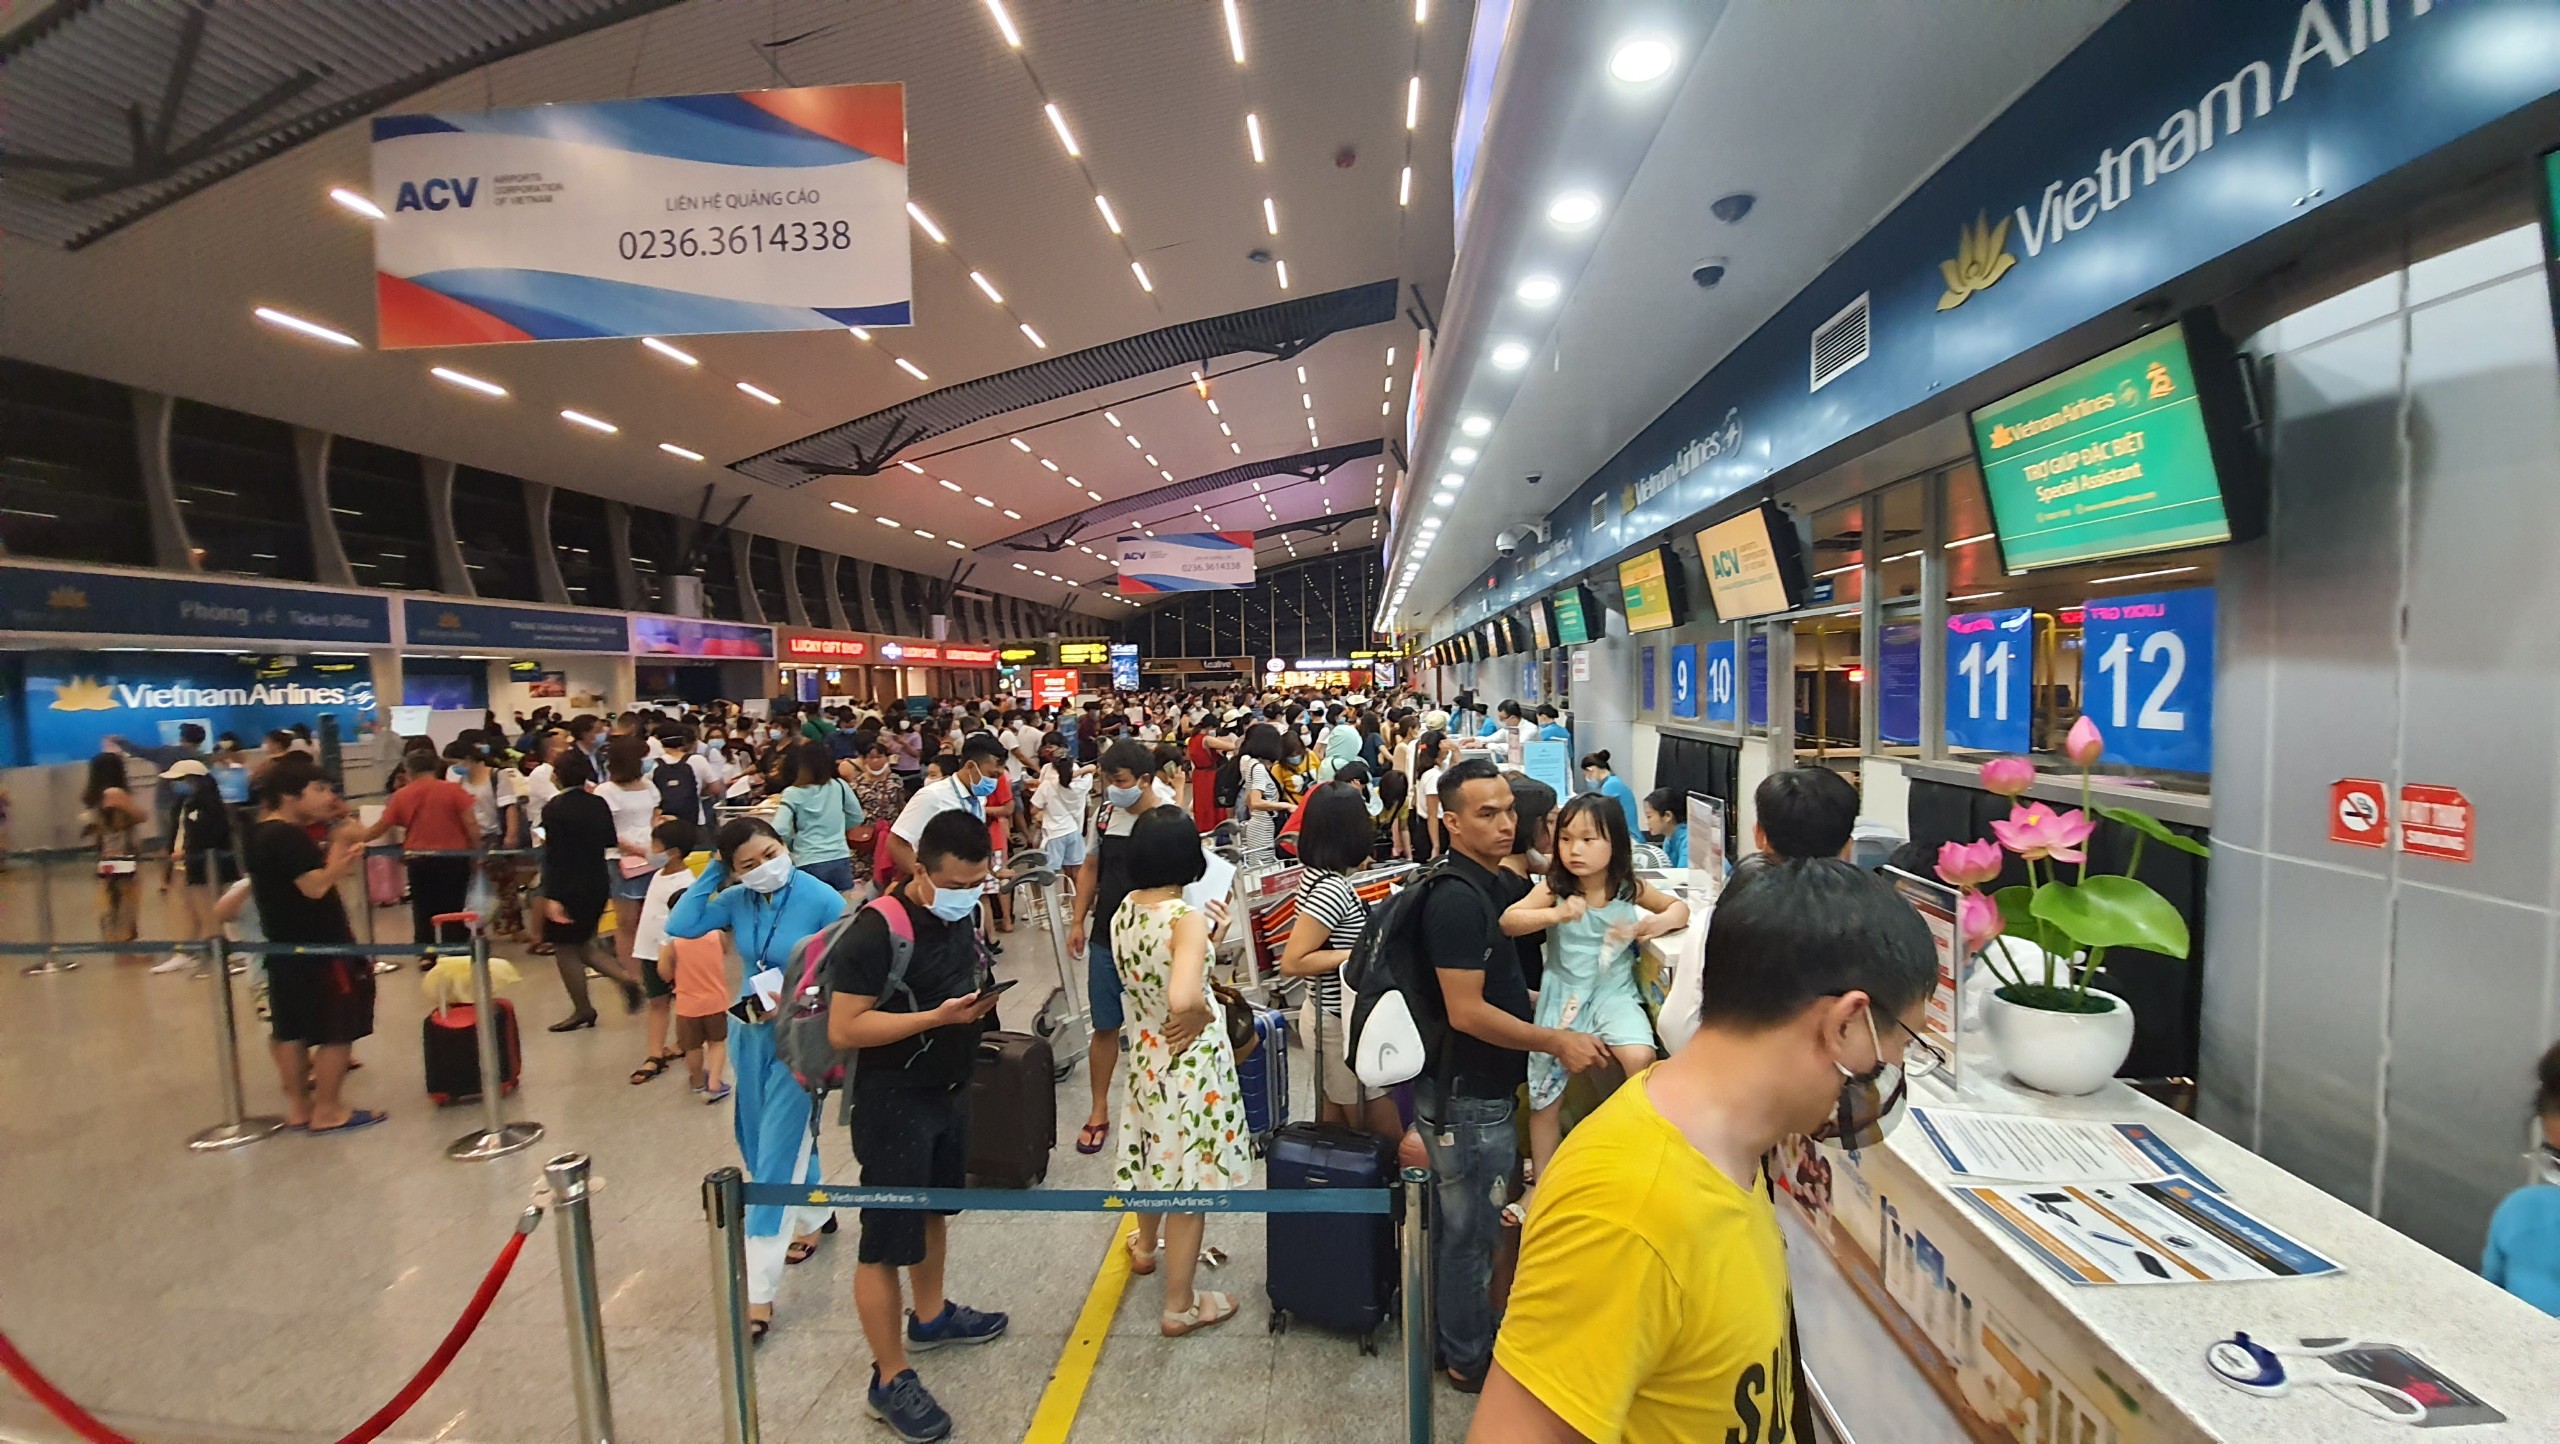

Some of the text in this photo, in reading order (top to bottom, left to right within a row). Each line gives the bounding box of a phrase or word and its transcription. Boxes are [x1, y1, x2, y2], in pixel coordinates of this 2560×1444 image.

[2015, 60, 2272, 257] Vietnam
[396, 177, 479, 212] ACV
[786, 188, 820, 205] CÁO
[619, 220, 851, 260] 0236.3614338
[2009, 412, 2063, 441] Vietnam
[2062, 392, 2116, 422] Airlines
[1635, 463, 1679, 505] Vietnam
[2035, 462, 2144, 504] Special Assistant
[1123, 552, 1146, 560] ACV
[1711, 547, 1740, 580] ACV
[118, 683, 345, 708] Vietnam Airlines
[1677, 660, 1688, 701] 9
[1709, 658, 1731, 704] 10
[1959, 641, 2009, 720] 11
[2098, 631, 2187, 731] 12
[830, 1192, 915, 1203] Vietnam Airlines
[1124, 1196, 1214, 1208] Vietnam Airlines
